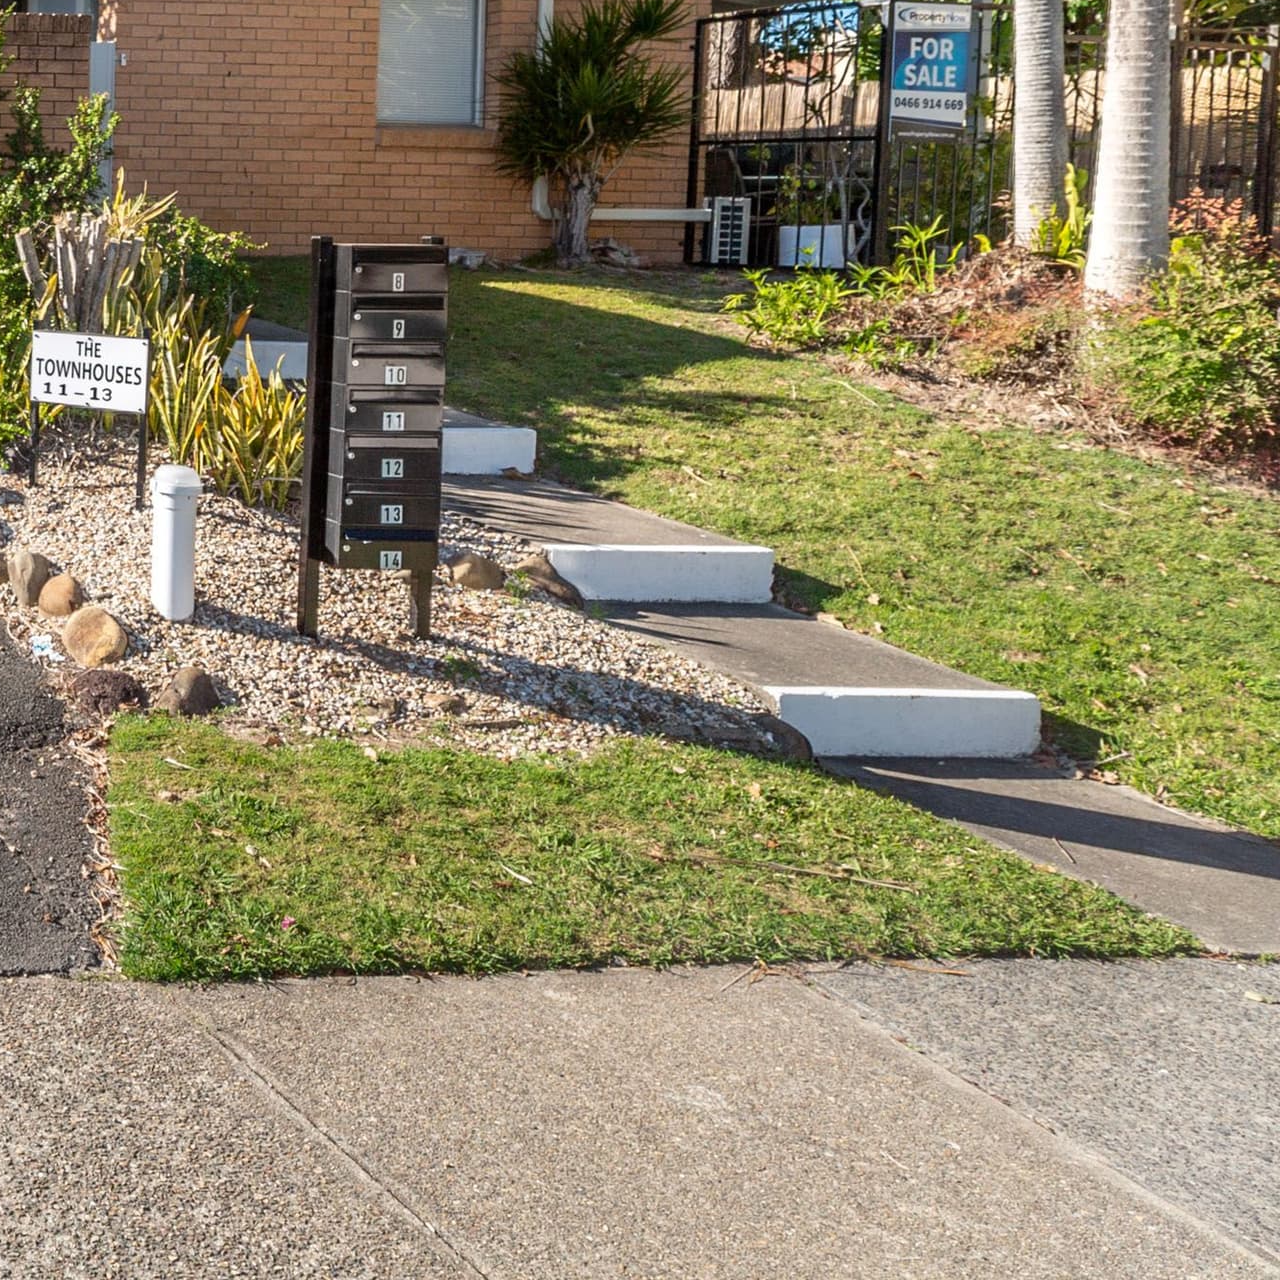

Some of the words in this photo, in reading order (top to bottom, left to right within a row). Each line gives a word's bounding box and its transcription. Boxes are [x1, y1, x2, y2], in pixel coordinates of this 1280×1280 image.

[910, 37, 954, 60] FOR
[904, 64, 957, 87] SALE
[894, 97, 920, 109] 0466
[922, 98, 941, 110] 914
[944, 99, 964, 111] 669
[394, 274, 403, 290] 8
[395, 321, 403, 337] 9
[76, 341, 102, 358] THE
[36, 358, 142, 385] TOWNHOUSES
[388, 367, 405, 384] 10
[386, 413, 402, 429] 11
[385, 460, 402, 476] 12
[384, 506, 401, 522] 13
[383, 552, 400, 568] 14
